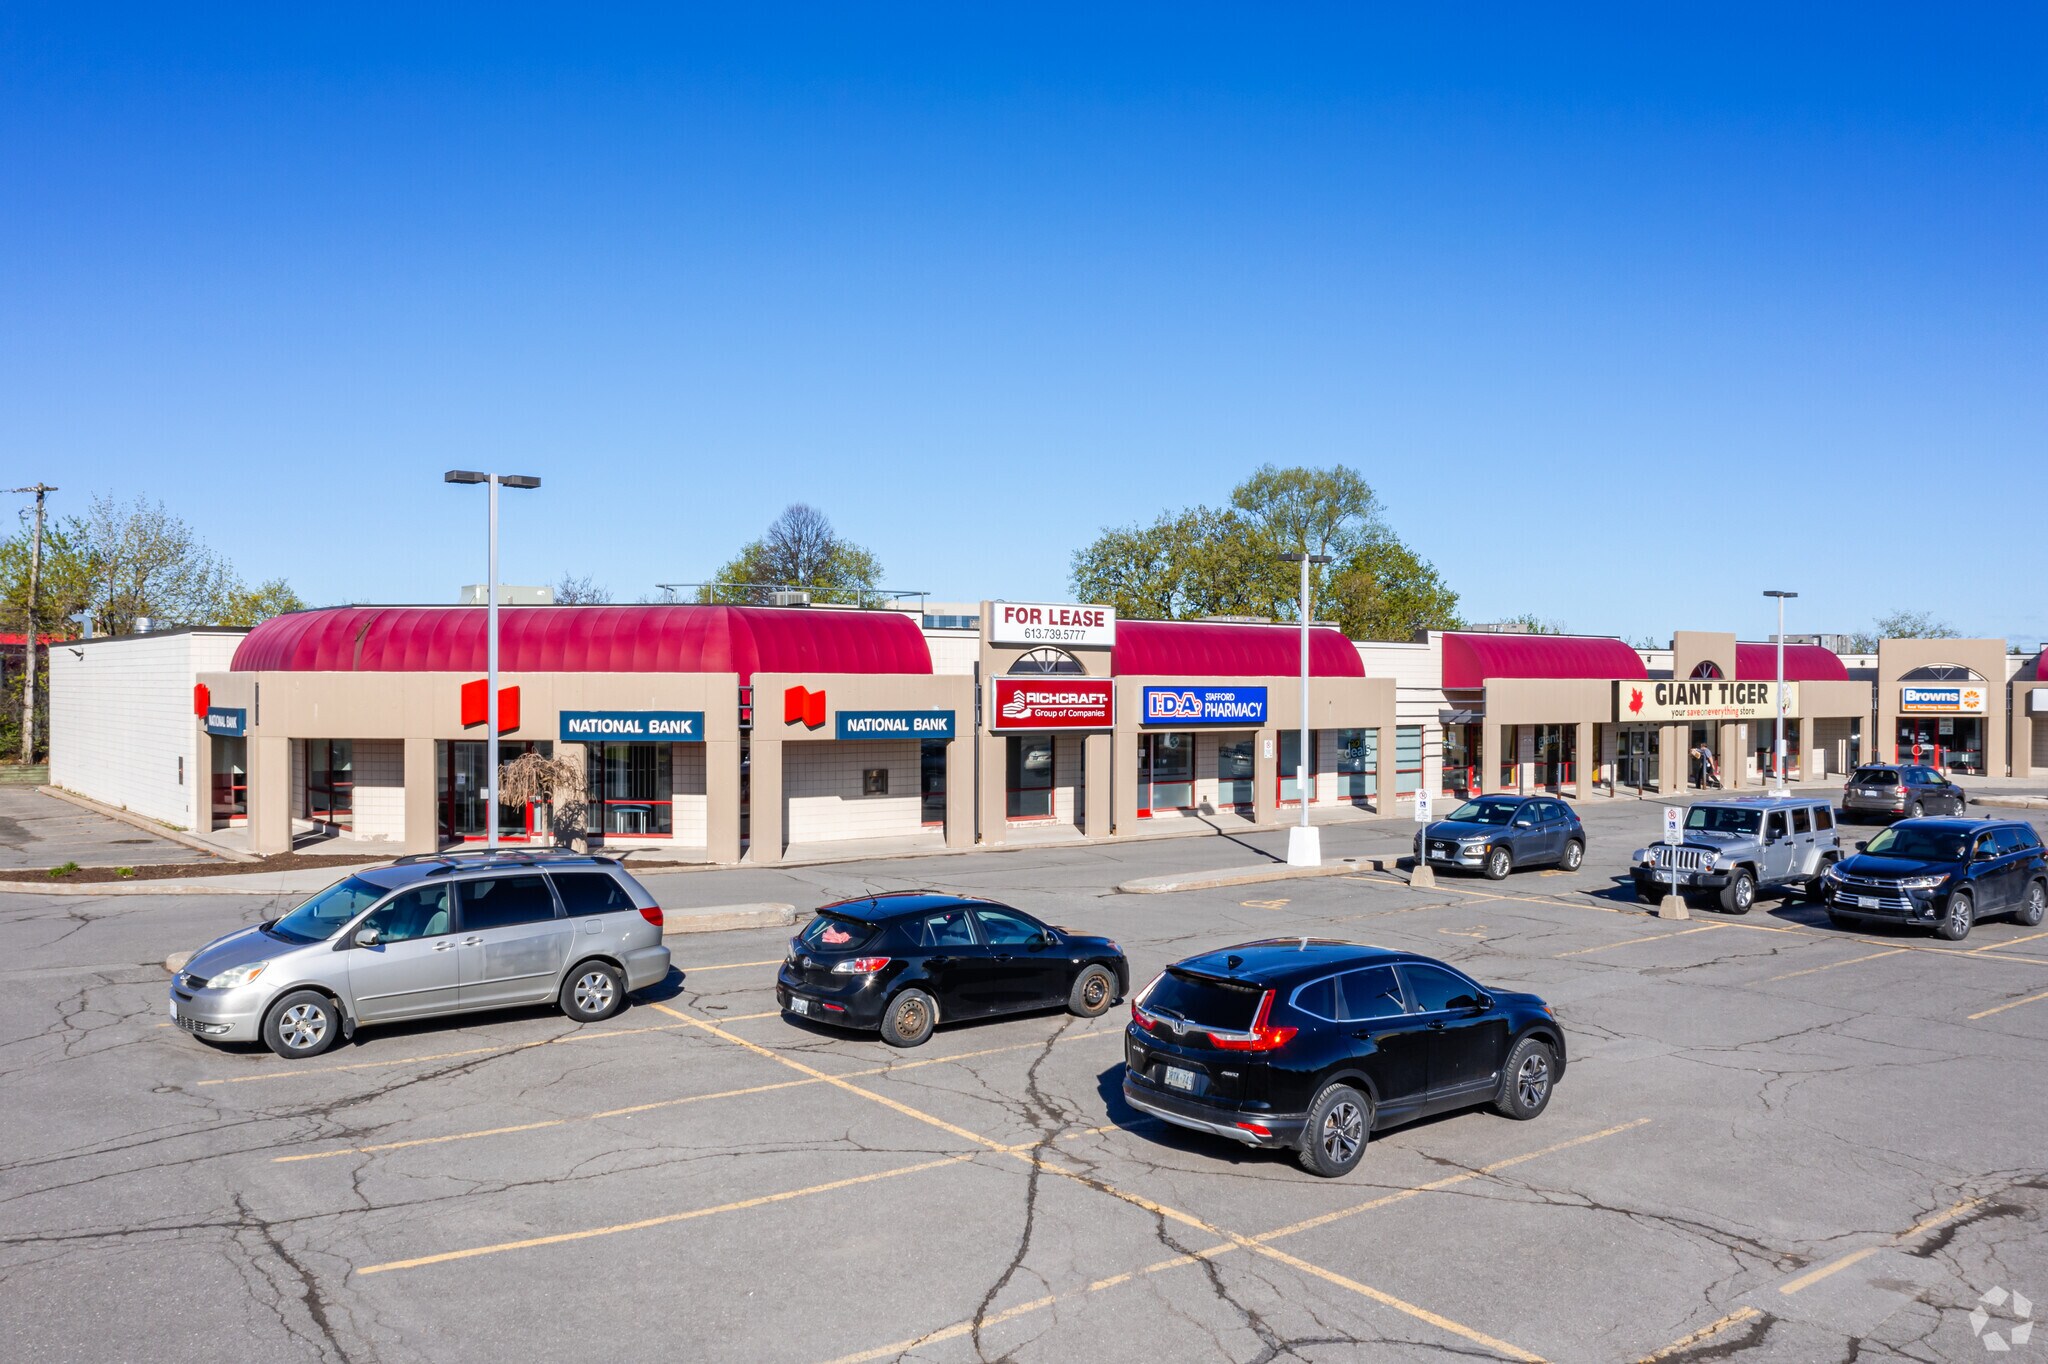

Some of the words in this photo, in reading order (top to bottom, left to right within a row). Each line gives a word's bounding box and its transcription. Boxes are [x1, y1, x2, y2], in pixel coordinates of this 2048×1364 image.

[1004, 606, 1042, 625] FOR
[1048, 609, 1105, 628] LEASE
[1024, 627, 1086, 640] 613.739.5777
[1026, 692, 1106, 704] RICHCRAFT
[1205, 692, 1235, 701] STAFFORD
[1655, 683, 1713, 706] GIANT
[1718, 682, 1769, 705] TIGER
[1905, 689, 1959, 702] Browns
[1034, 709, 1058, 718] Group
[1058, 709, 1067, 717] of
[1067, 709, 1105, 718] Companies
[1204, 702, 1263, 718] PHARMACY
[1671, 709, 1686, 719] your
[1739, 707, 1755, 716] store
[568, 718, 644, 734] NATIONAL
[648, 719, 693, 735] BANK
[847, 717, 911, 732] NATIONAL
[913, 717, 948, 732] BANK
[1344, 740, 1371, 759] deals
